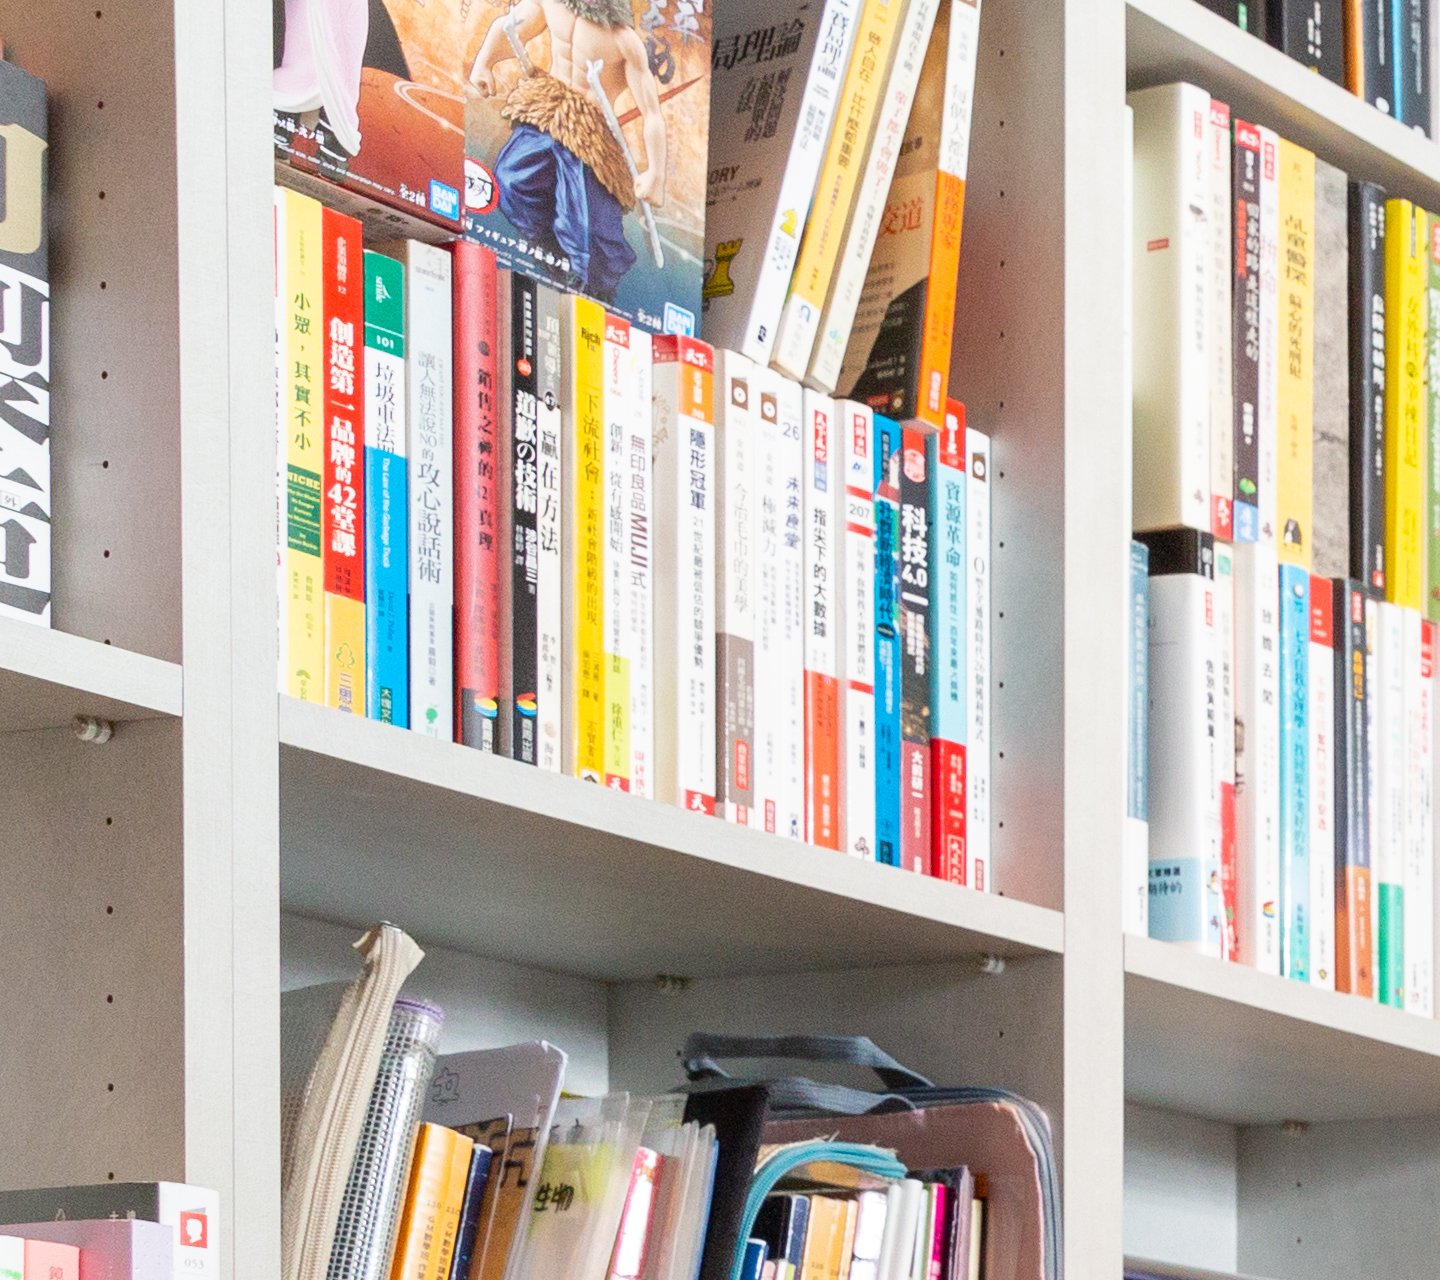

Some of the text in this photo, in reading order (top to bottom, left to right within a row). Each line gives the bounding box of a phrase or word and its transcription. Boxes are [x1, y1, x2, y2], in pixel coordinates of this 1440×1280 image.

[432, 182, 457, 204] BAN
[432, 196, 457, 217] DAI
[605, 324, 629, 346] 天下
[667, 305, 692, 325] BAN
[376, 335, 395, 349] 101
[685, 348, 709, 367] 天下
[293, 293, 312, 452] 小眾，其實不小
[327, 317, 358, 557] 創造第一品牌的42堂課
[515, 389, 538, 514] 道歉の技術
[814, 409, 827, 462] 天下文化
[416, 350, 442, 586] 讓人無法說NO的攻心說話術
[540, 428, 559, 557] 贏在方法
[688, 427, 707, 512] 隱形冠軍
[848, 503, 871, 520] 207
[944, 480, 962, 568] 資源革命
[901, 504, 929, 589] 科技4.0
[813, 508, 828, 639] 指尖下的大數據
[533, 1182, 575, 1213] 生物
[184, 1257, 206, 1270] 053
